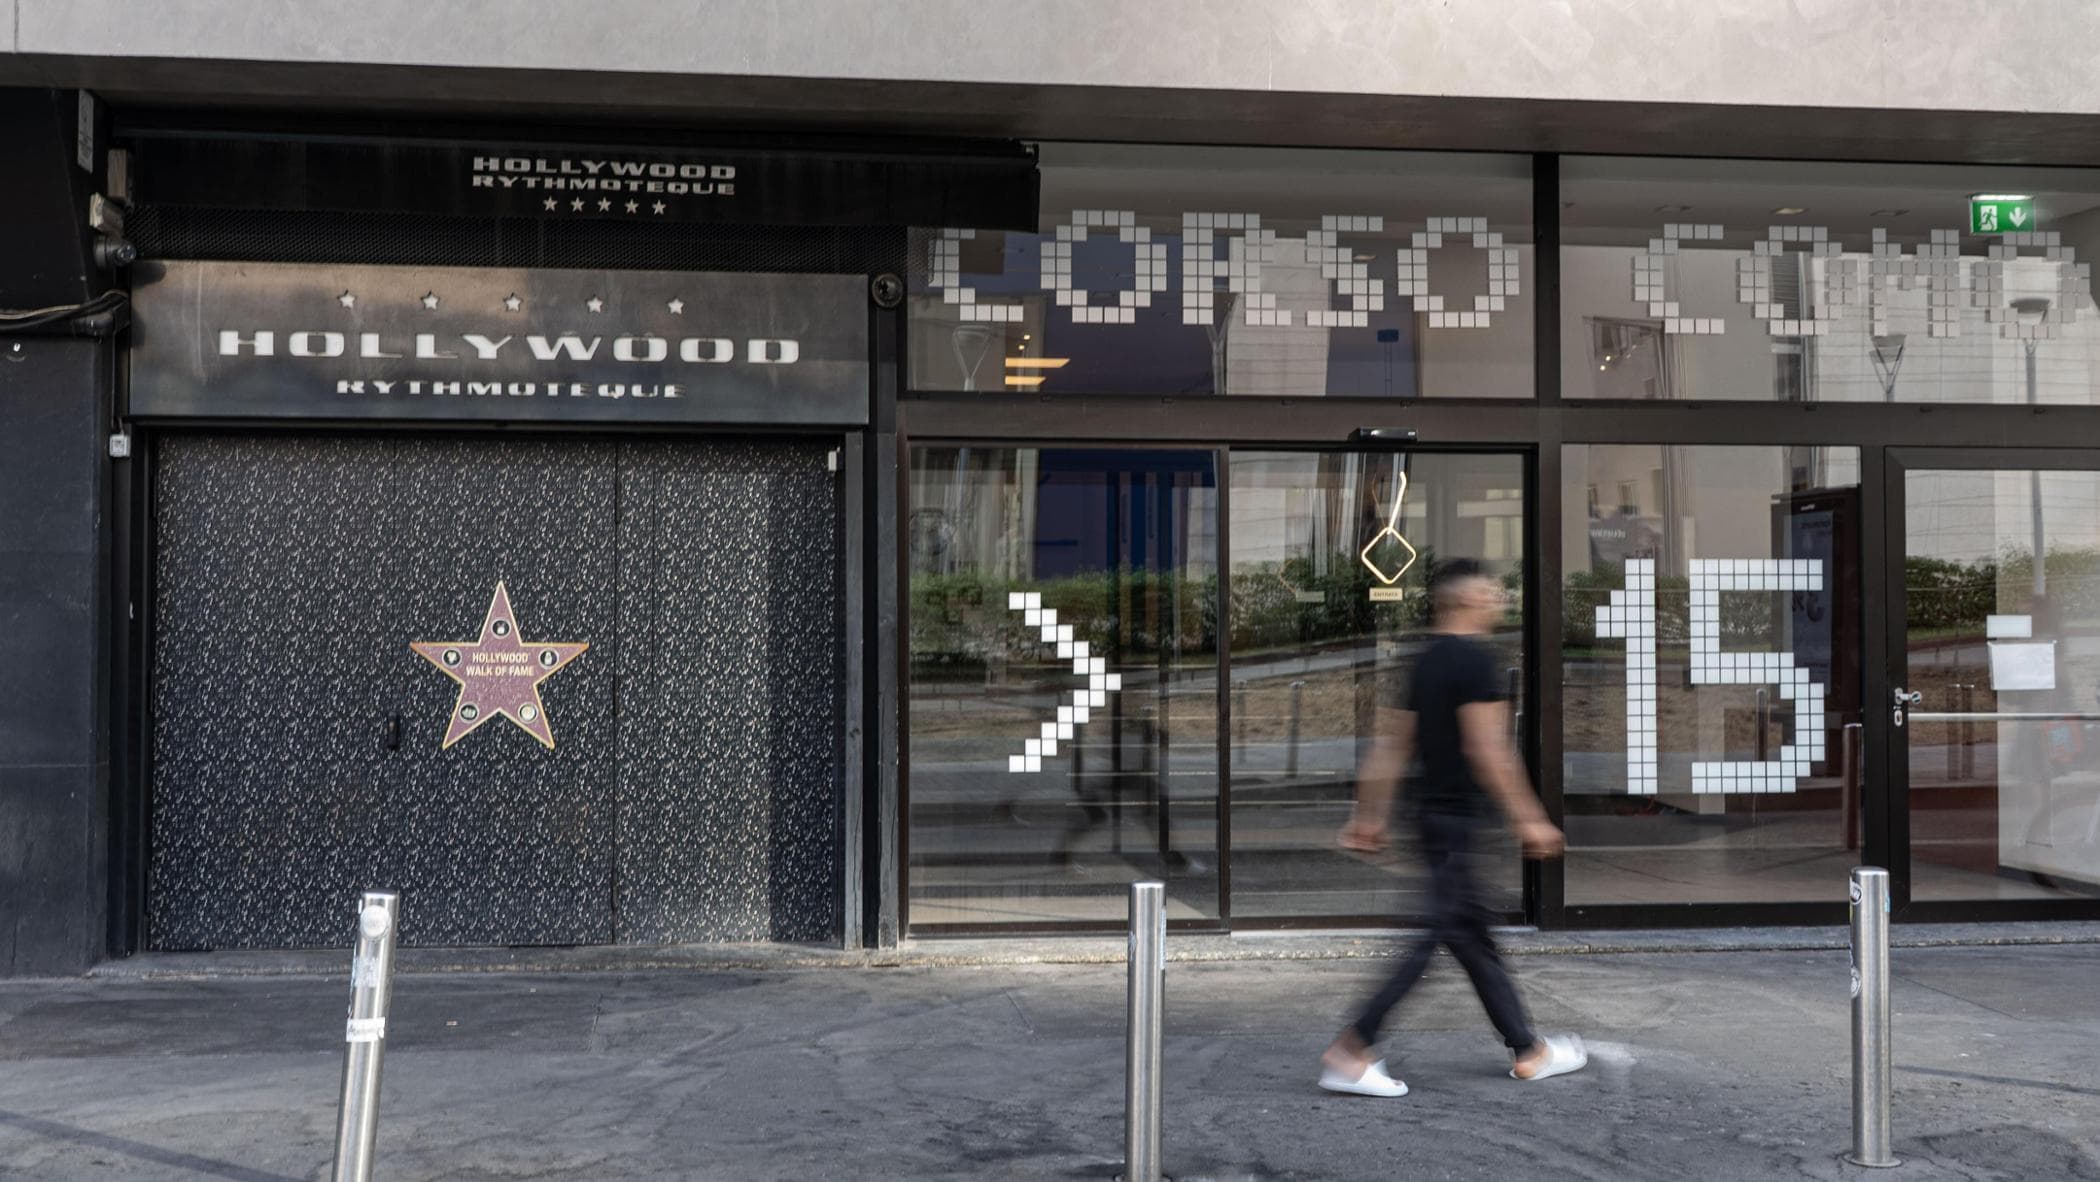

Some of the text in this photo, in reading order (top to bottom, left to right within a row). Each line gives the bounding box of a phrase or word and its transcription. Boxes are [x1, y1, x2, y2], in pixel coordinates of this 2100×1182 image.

[472, 156, 736, 180] HOLLYWOOD
[472, 175, 736, 195] RYTHMOTEQUE
[928, 209, 2091, 340] CORSO COMO
[218, 330, 800, 365] HOLLYWOOD
[336, 379, 687, 399] RYTHMOTEQUE
[472, 652, 529, 664] HOLLYWOOD
[466, 665, 534, 677] WALK OF FAME
[1595, 558, 1825, 795] 15
